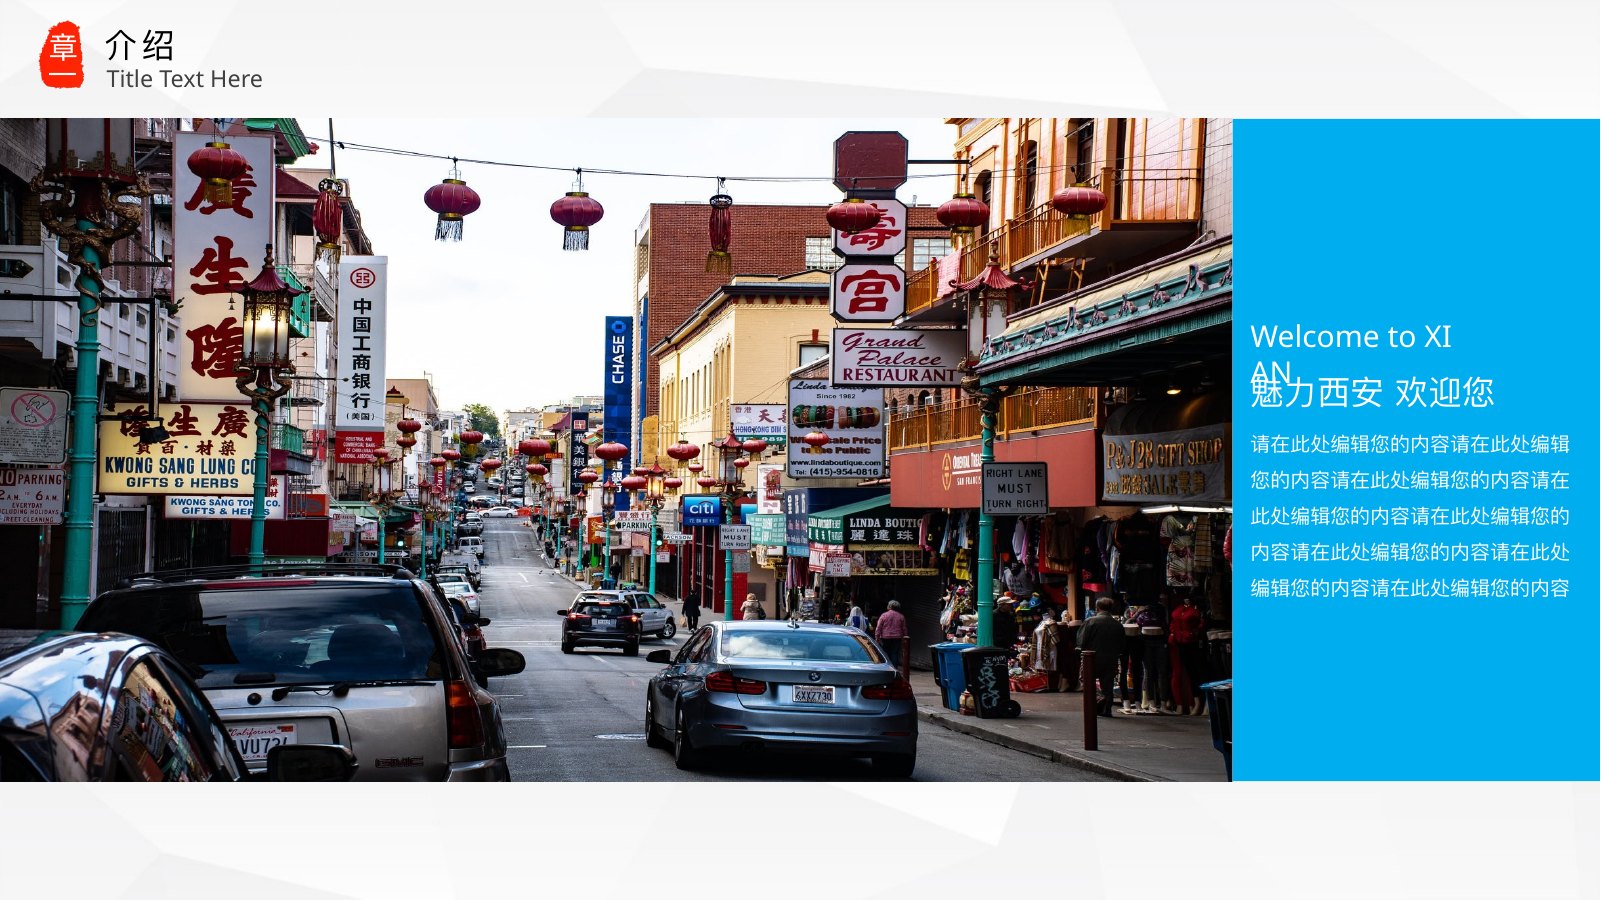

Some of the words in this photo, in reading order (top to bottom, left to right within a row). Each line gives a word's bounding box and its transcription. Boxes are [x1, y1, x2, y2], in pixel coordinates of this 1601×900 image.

[842, 332, 925, 353] Grand
[350, 298, 372, 408] 中国工商银行
[857, 349, 942, 366] Palace
[611, 335, 624, 384] CHASE
[843, 368, 958, 383] RESTAURANT
[735, 425, 752, 433] HONG
[852, 436, 881, 444] Price
[835, 446, 871, 454] Public
[1155, 442, 1185, 468] GIFT
[1187, 437, 1223, 466] SHOP
[105, 456, 153, 474] KWONG
[159, 457, 195, 475] SANG
[200, 458, 236, 475] LUNG
[790, 458, 881, 467] www.lindaboutique.com
[809, 468, 879, 476] (415)-954-0816
[986, 469, 1014, 478] RIGHT
[1018, 469, 1044, 478] LANE
[18, 473, 62, 485] PARKING
[126, 477, 169, 488] GIFTS
[174, 477, 185, 488] &
[190, 477, 239, 489] HERBS
[998, 483, 1033, 494] MUST
[35, 490, 43, 500] 6
[171, 498, 207, 507] KWONG
[209, 498, 235, 507] SANG
[237, 499, 255, 507] TON
[986, 499, 1012, 508] TURN
[1017, 499, 1044, 508] RIGHT
[182, 507, 215, 515] GIFTS
[219, 507, 228, 515] &
[232, 507, 270, 516] HERS
[689, 503, 715, 514] citi
[849, 518, 881, 528] LINDA
[230, 728, 277, 738] California
